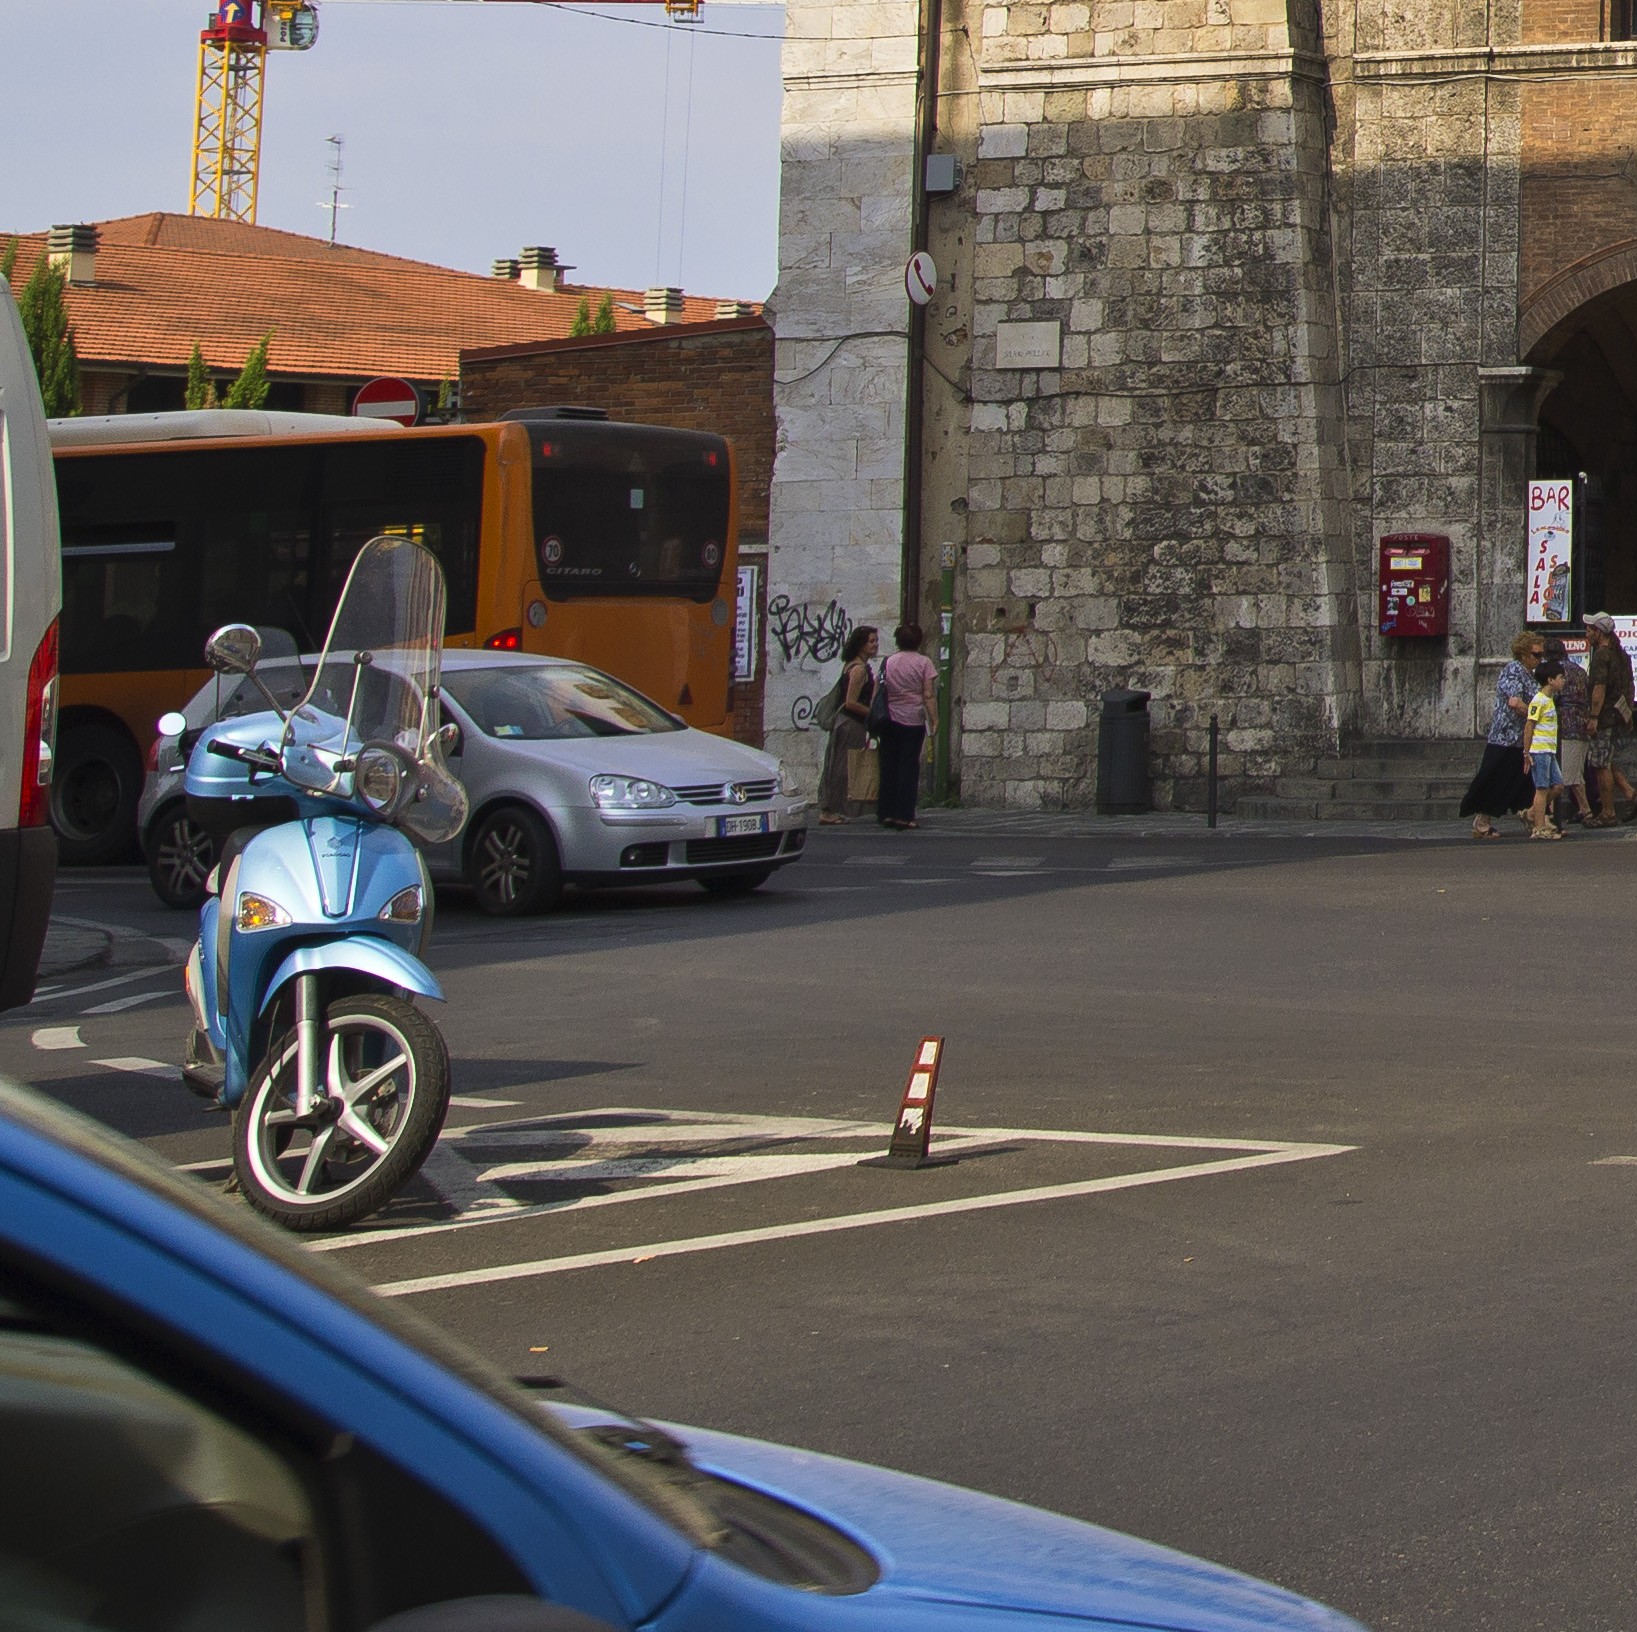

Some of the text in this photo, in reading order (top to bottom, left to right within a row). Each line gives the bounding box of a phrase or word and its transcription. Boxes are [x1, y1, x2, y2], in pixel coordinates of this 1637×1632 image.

[1530, 486, 1570, 511] BAR
[546, 567, 602, 576] CITARO
[1529, 540, 1548, 605] SALA
